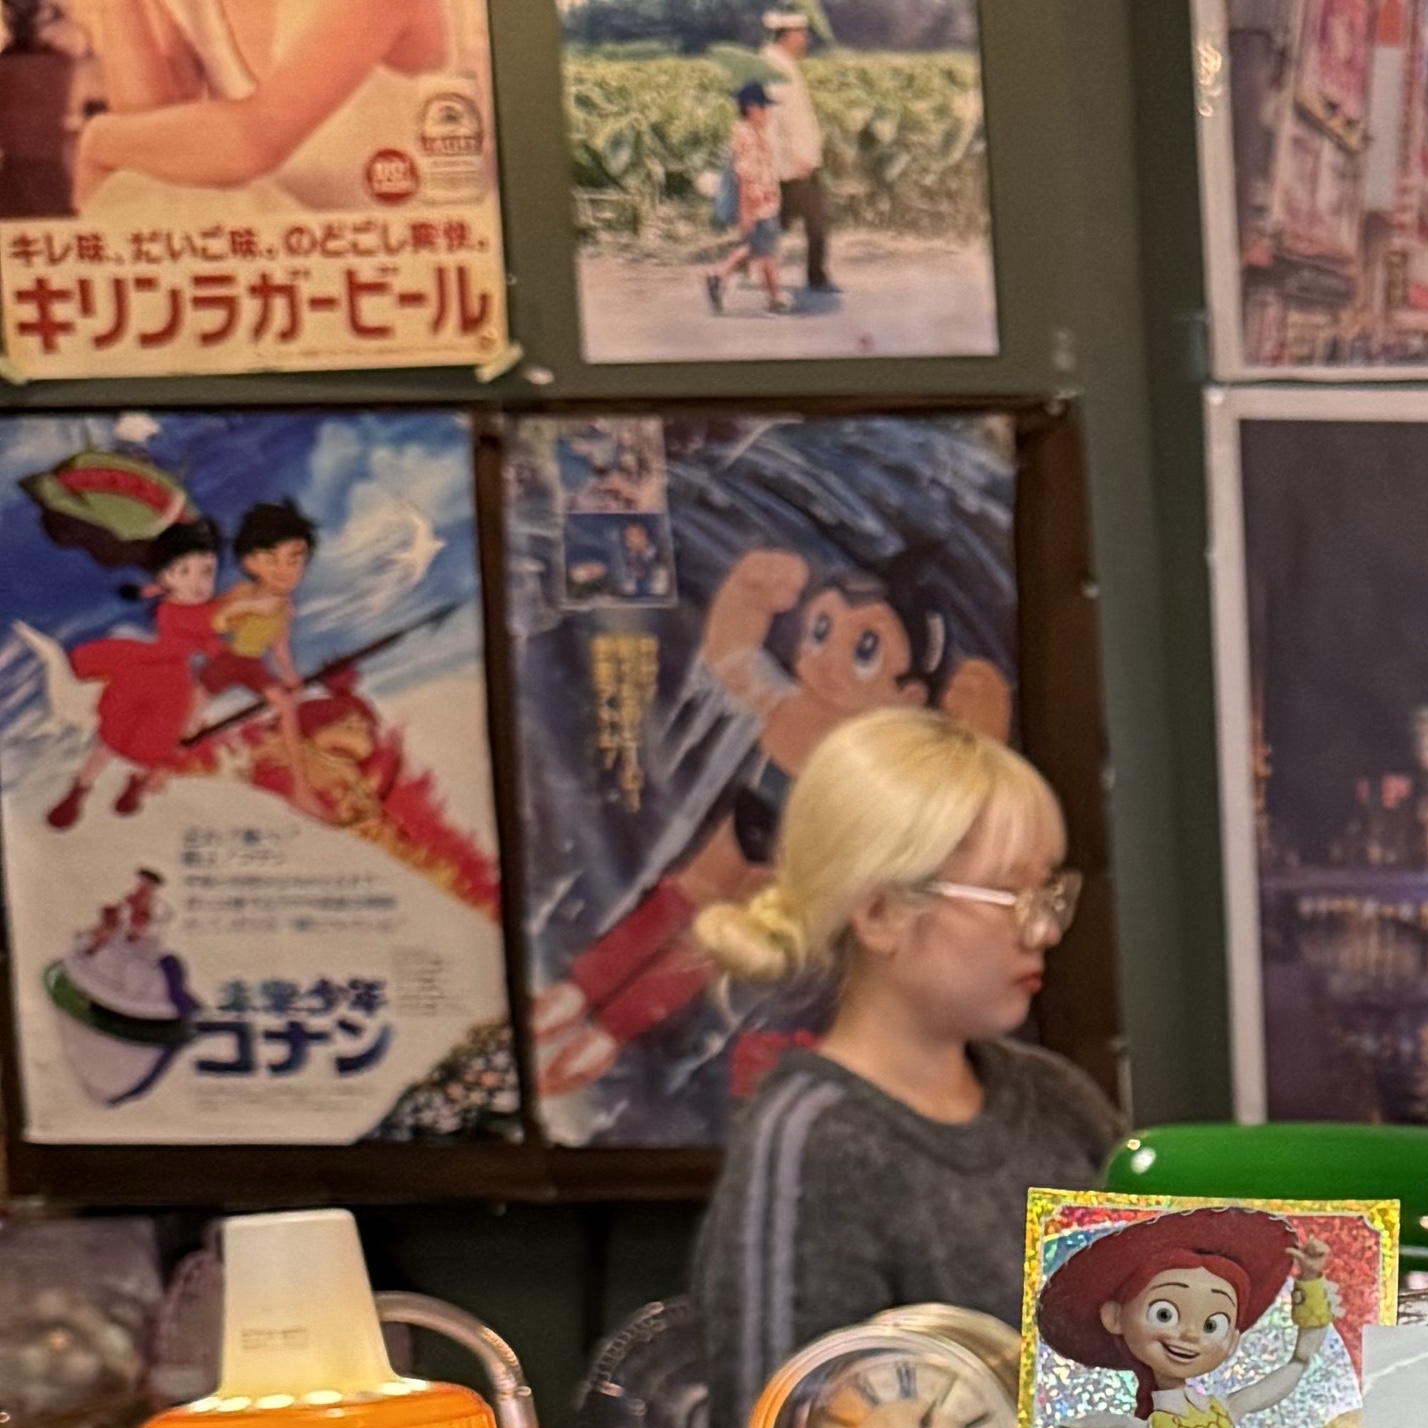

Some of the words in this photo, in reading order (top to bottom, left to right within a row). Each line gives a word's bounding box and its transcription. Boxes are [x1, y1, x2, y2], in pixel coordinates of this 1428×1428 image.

[15, 265, 494, 355] キリンラガービール
[194, 1021, 395, 1077] コナン
